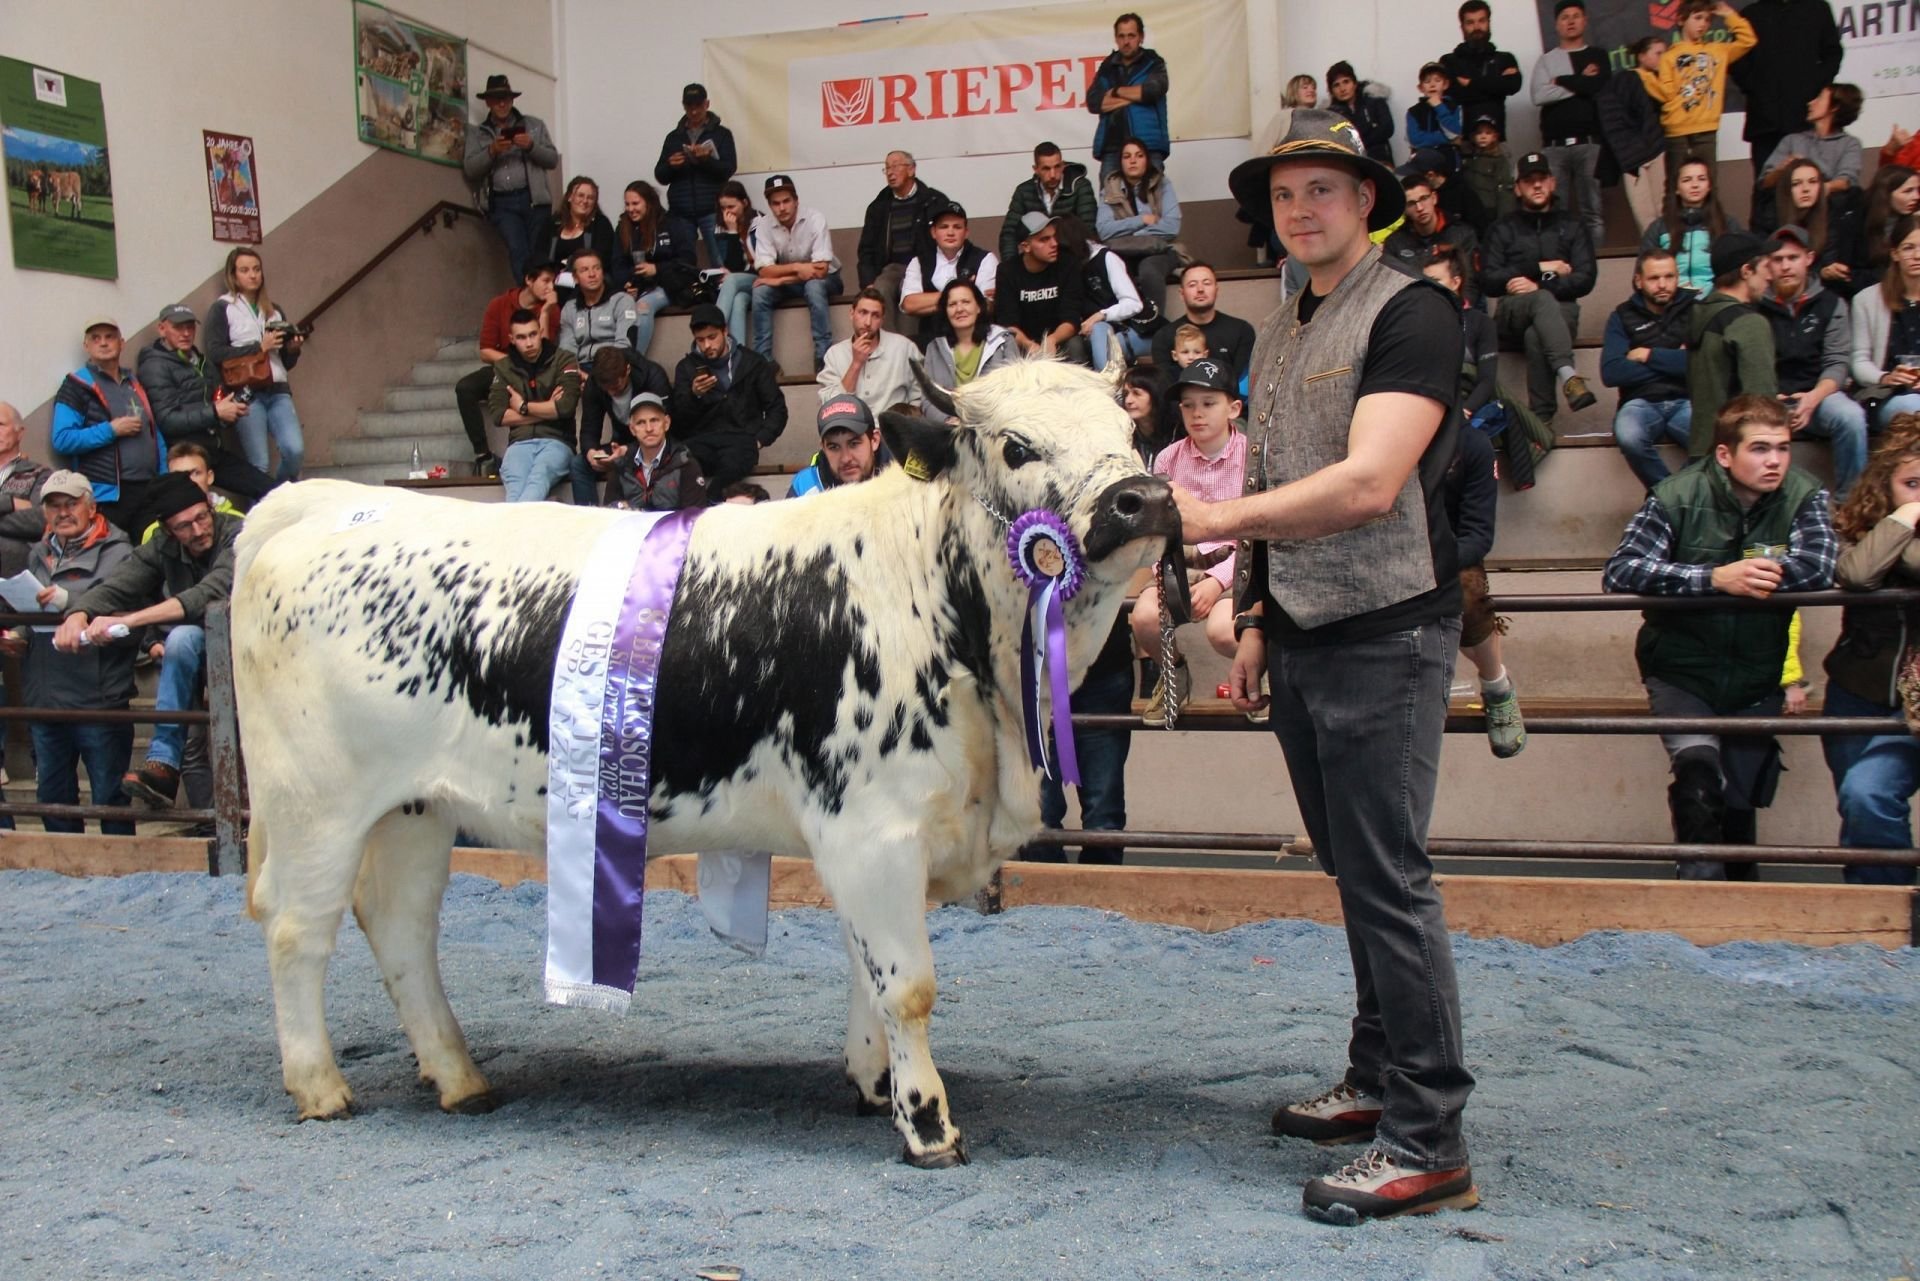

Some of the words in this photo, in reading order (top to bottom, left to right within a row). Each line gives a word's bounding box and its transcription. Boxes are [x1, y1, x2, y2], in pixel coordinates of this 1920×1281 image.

[206, 136, 215, 148] 20
[217, 138, 239, 151] JAHRE
[1020, 286, 1058, 302] FIRENZE
[601, 676, 626, 754] Lorenzen
[618, 635, 659, 824] BEZIRKSSCHAU
[599, 758, 619, 800] 2022
